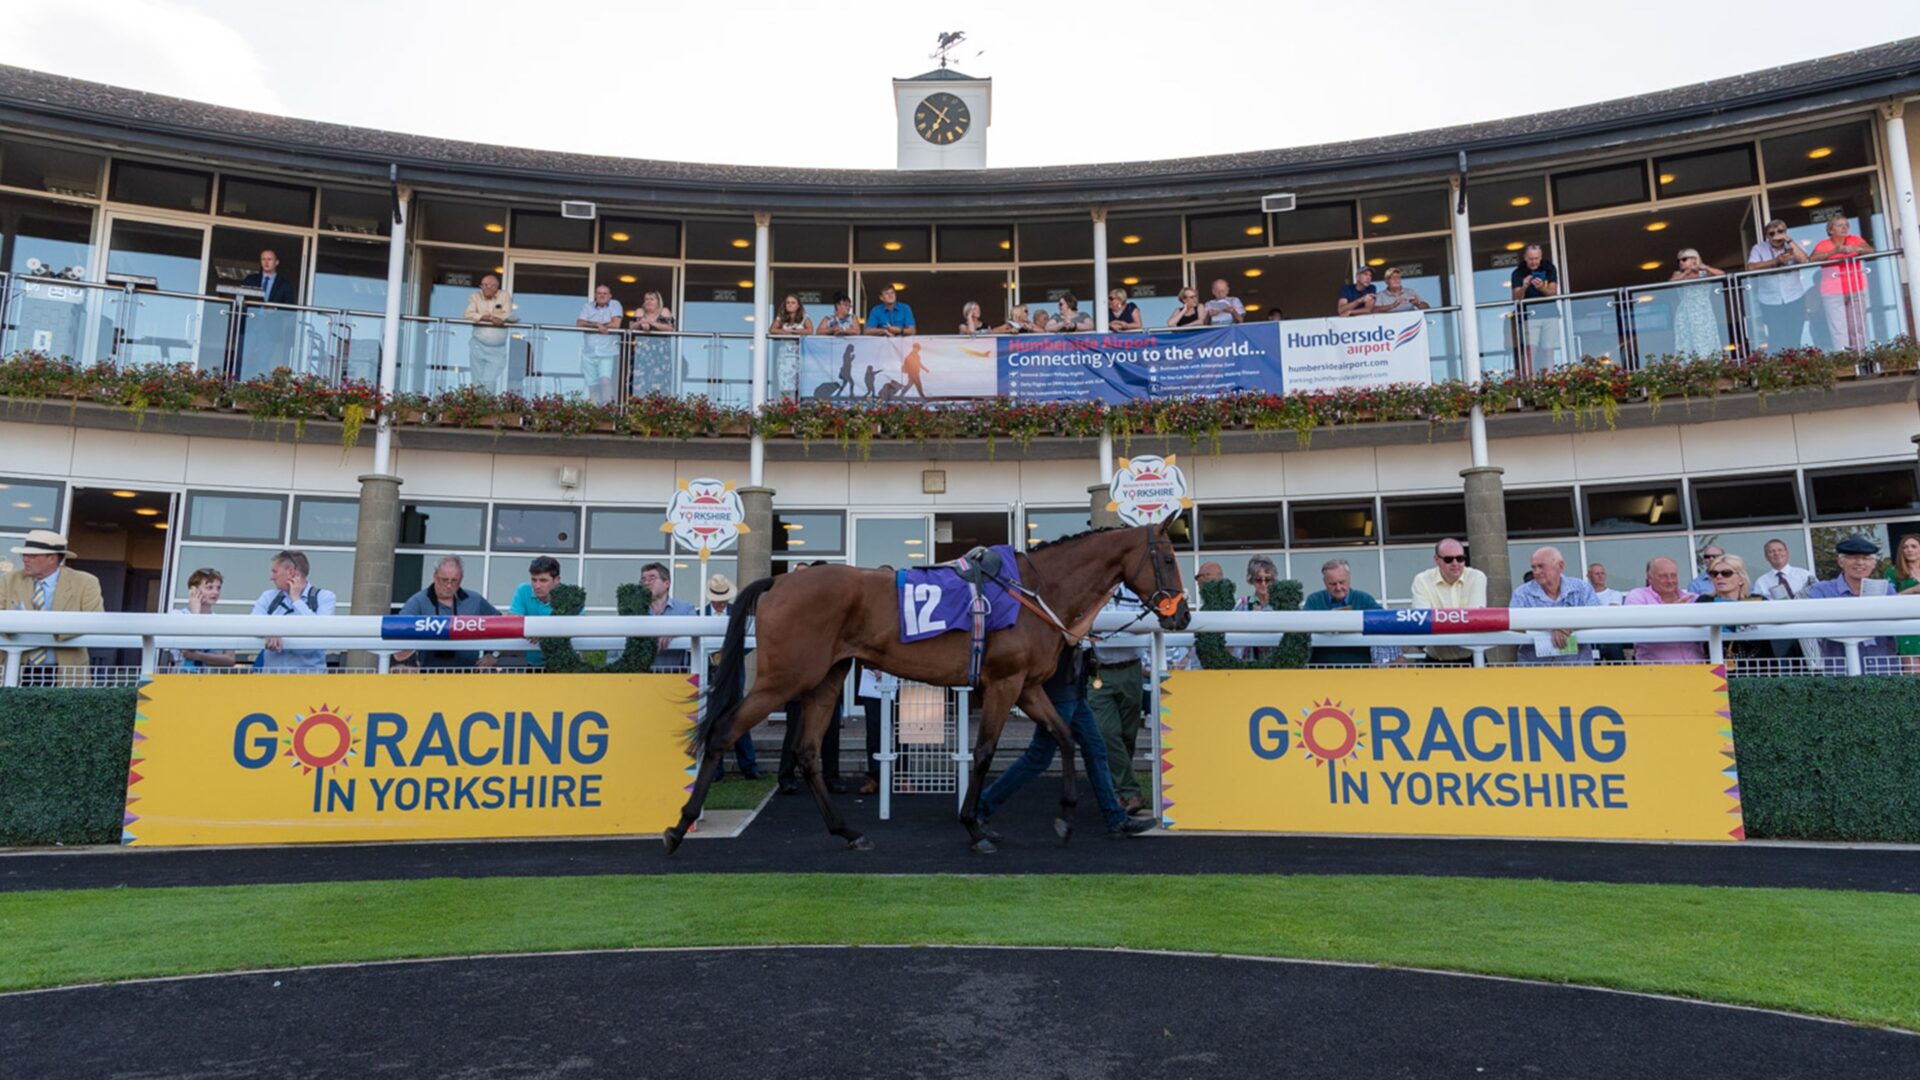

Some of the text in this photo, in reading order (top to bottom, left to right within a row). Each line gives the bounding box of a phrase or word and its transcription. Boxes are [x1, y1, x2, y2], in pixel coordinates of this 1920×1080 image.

[1009, 336, 1158, 352] Humberside Airport
[1287, 325, 1396, 349] Humberside
[1008, 341, 1266, 368] Connecting you to the world...
[1347, 342, 1391, 356] airport
[1288, 360, 1389, 373] humbersideairport.com
[1122, 488, 1174, 499] YORKSHIRE
[679, 511, 732, 521] YORKSHIRE
[904, 583, 946, 636] 12
[1396, 609, 1469, 626] sky bet
[414, 616, 487, 634] sky bet
[364, 711, 609, 767] RACING
[1369, 706, 1627, 763] RACING
[313, 768, 603, 813] IN YORKSHIRE
[1328, 759, 1628, 809] IN YORKSHIRE
